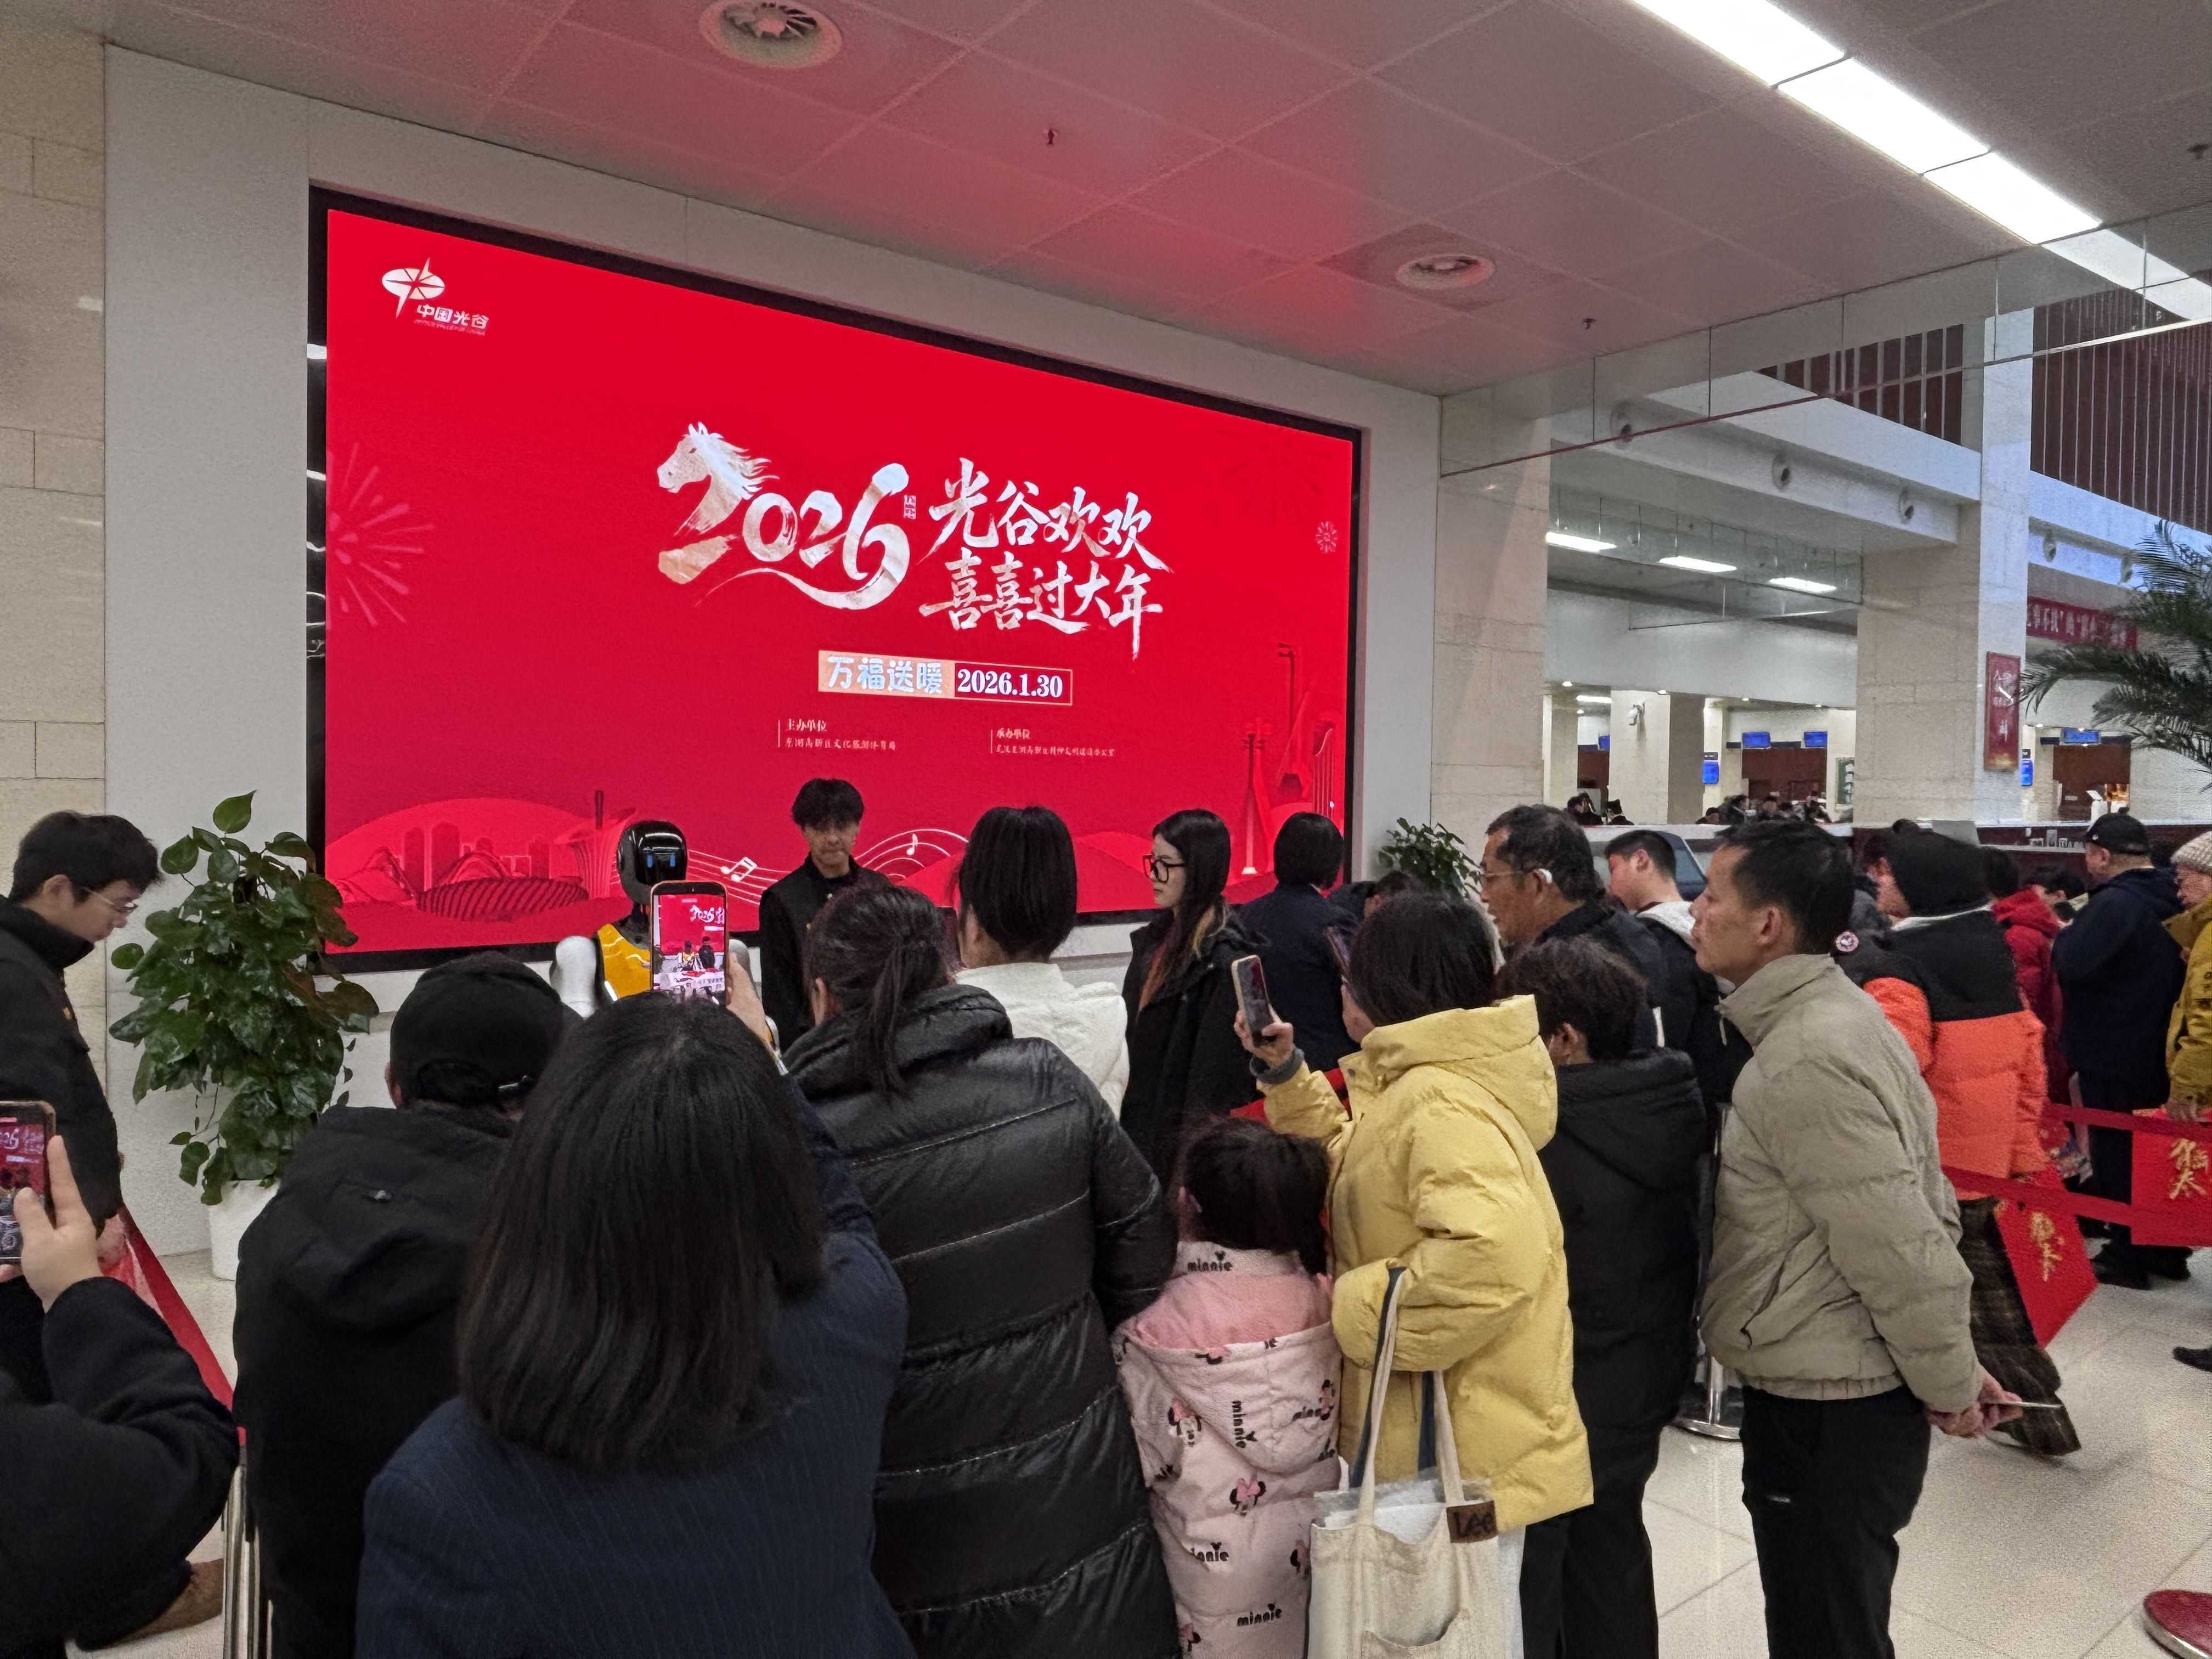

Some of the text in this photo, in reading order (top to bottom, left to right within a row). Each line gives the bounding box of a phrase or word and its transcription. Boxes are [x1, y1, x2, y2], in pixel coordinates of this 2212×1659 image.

[416, 304, 490, 330] 中国光谷
[657, 420, 910, 610] 2026
[916, 456, 1174, 574] 光谷欢欢
[919, 547, 1165, 661] 喜喜过大年
[827, 655, 943, 695] 万福送暖
[957, 668, 1063, 698] 2026.1.30
[1187, 1251, 1233, 1272] minnie
[1232, 1401, 1257, 1449] minnie
[1237, 1603, 1282, 1626] minnie
